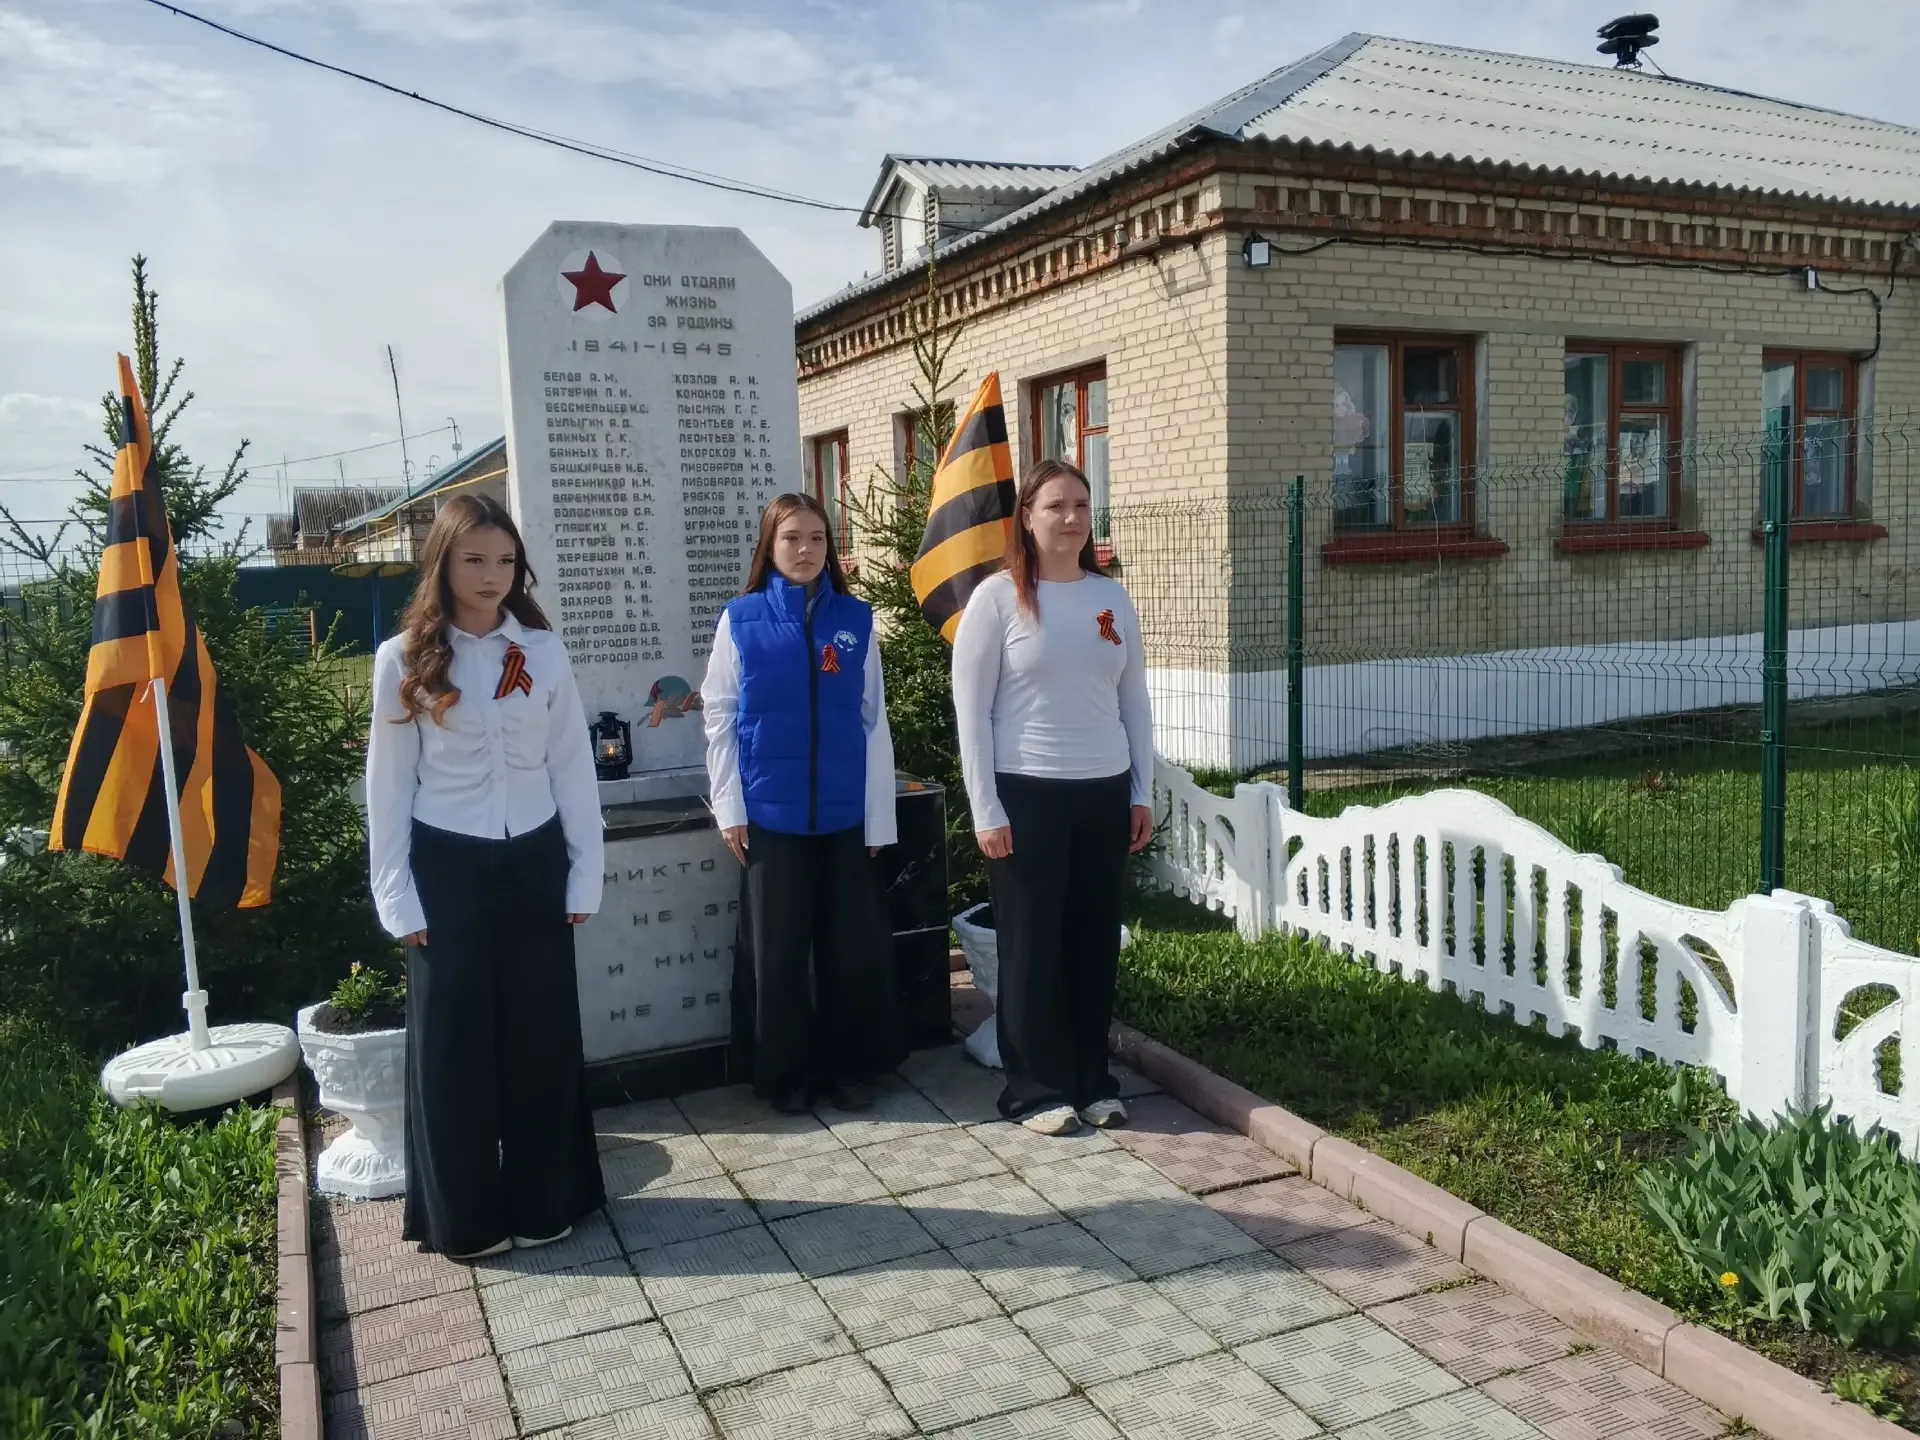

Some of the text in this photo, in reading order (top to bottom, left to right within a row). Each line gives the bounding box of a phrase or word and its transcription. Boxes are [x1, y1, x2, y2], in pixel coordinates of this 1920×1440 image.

[643, 274, 736, 290] ОНИ ОТДАЛИ
[666, 296, 717, 309] ЖИЗНЬ
[647, 316, 733, 330] ЗА РОДИНУ
[544, 372, 581, 382] БЕЛОВ
[675, 374, 717, 384] КОЗЛОВ
[545, 387, 597, 397] БАТУРИН
[676, 389, 725, 399] КОНОНОВ
[547, 418, 603, 428] БУЛЫГИН
[678, 419, 734, 429] ЛЕОНТЬЕВ
[548, 433, 596, 443] БАННЫХ
[679, 434, 735, 443] ЛЕОНТЬЕВ
[549, 448, 599, 458] БАННЫХ
[681, 448, 736, 458] ОКОРОКОВ
[683, 492, 724, 501] РЯБКОВ
[685, 520, 738, 530] УГРЮМОВ
[556, 537, 616, 547] ДЕГТЯРЕВ
[686, 534, 739, 544] УГРЮМОВ
[557, 552, 619, 563] ЖЕРЕБЦОВ
[686, 548, 740, 558] ФОМИЧЕВ
[688, 563, 741, 572] ФОМИЧЕВ
[559, 581, 611, 592] ЗАХАРОВ
[688, 577, 740, 587] ФЕДОСОВ
[561, 596, 613, 607] ЗАХАРОВ
[562, 610, 613, 621] ЗАХАРОВ
[690, 605, 720, 616] ХЛЫЗ
[562, 624, 637, 636] КАЙГОРОДОВ
[568, 652, 638, 665] АЙГОРОДОВ
[604, 859, 714, 884] НИКТО
[633, 910, 672, 925] НЕ
[608, 963, 624, 975] И
[611, 1004, 651, 1022] НЕ
